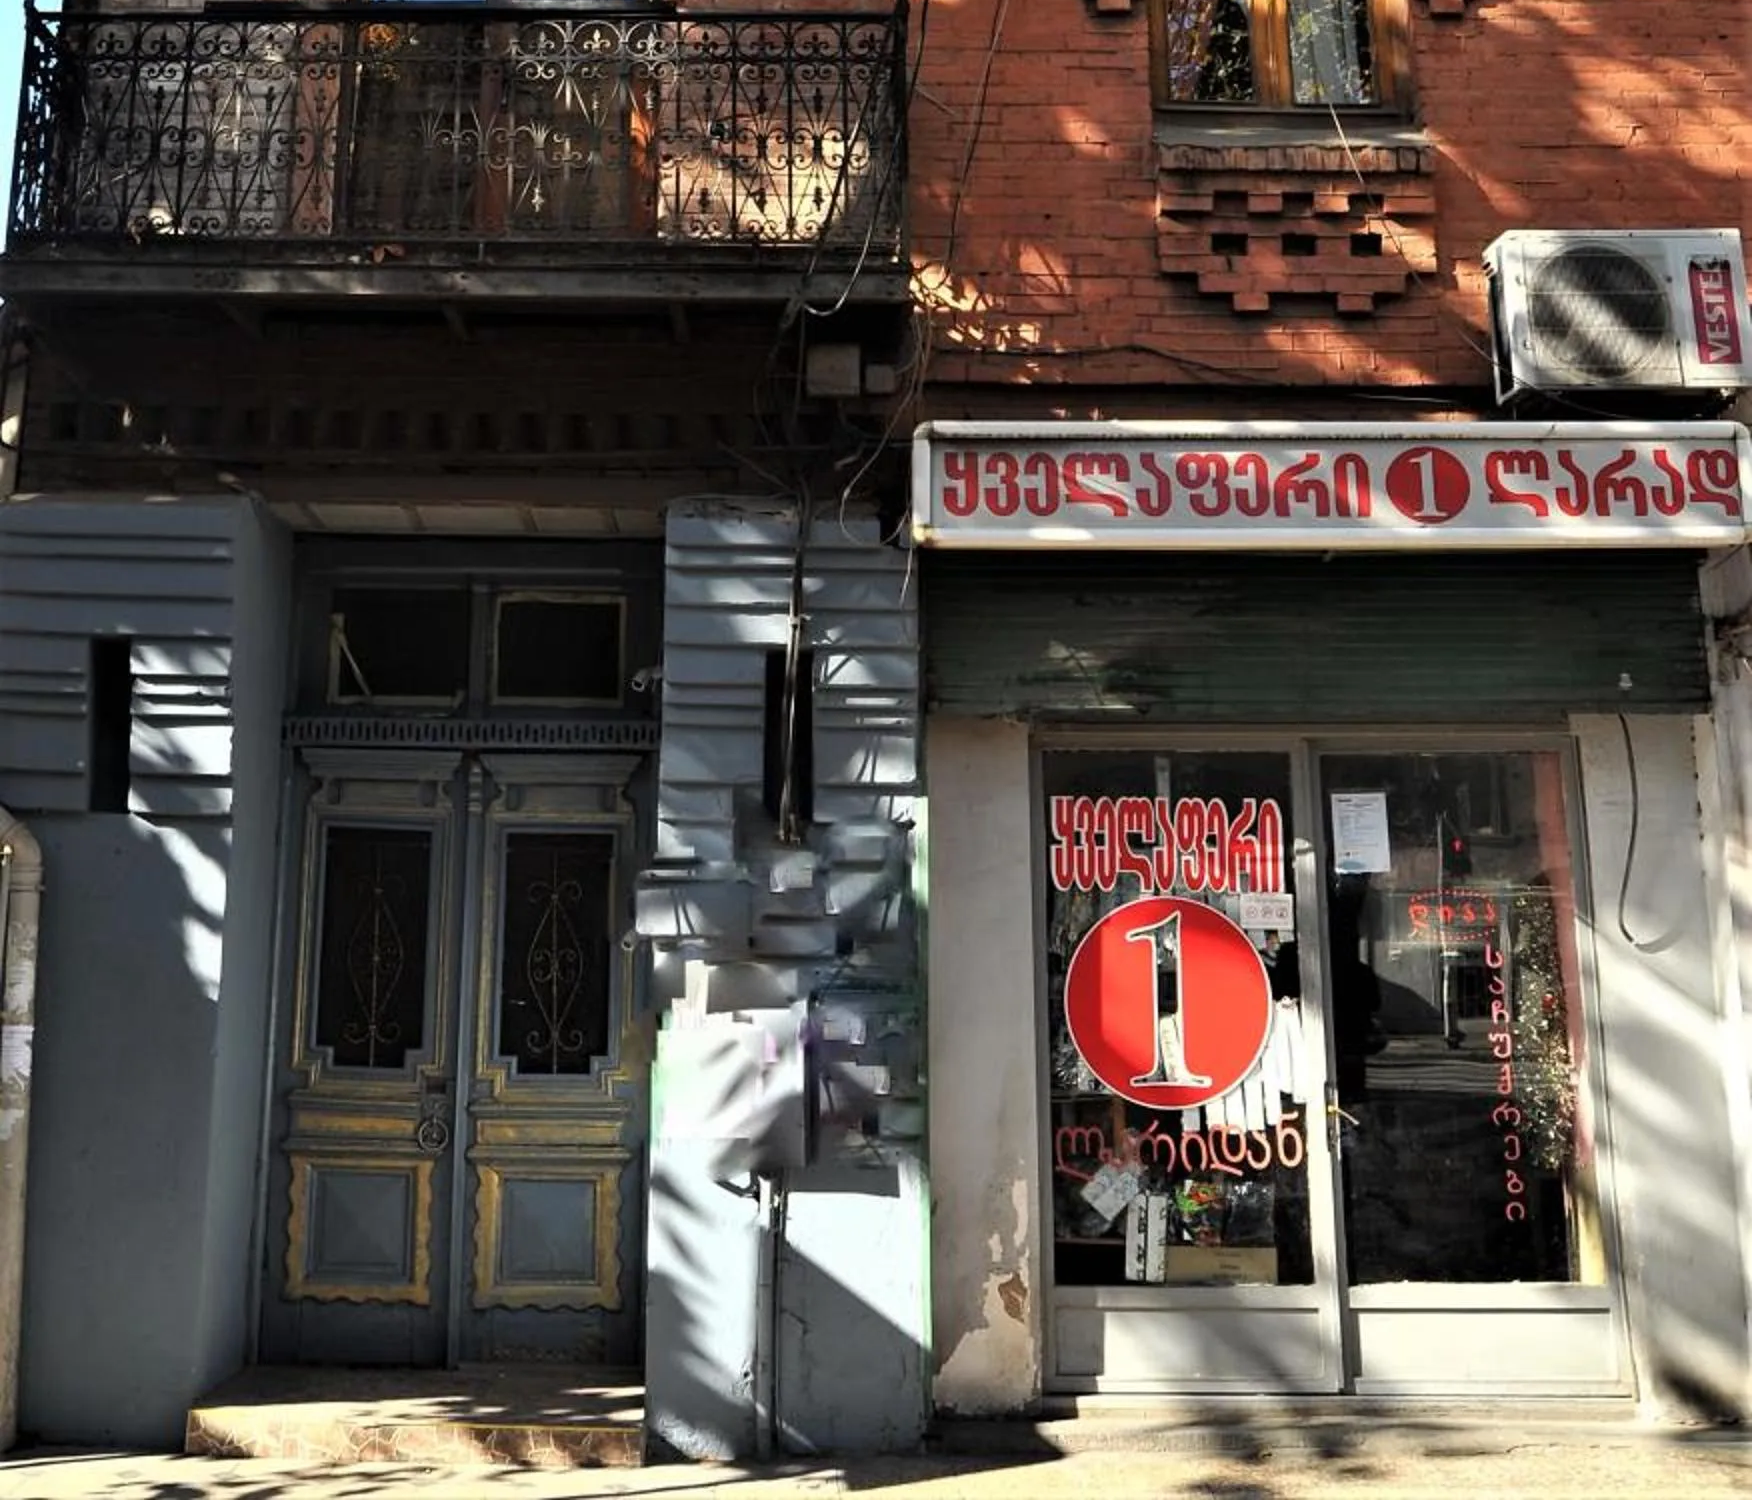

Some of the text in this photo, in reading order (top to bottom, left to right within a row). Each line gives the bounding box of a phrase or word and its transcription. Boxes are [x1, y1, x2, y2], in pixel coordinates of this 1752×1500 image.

[943, 449, 1741, 517] ყველაფერი 1 ლარად
[1051, 795, 1285, 893] ყველაფერი
[1125, 910, 1213, 1088] 1
